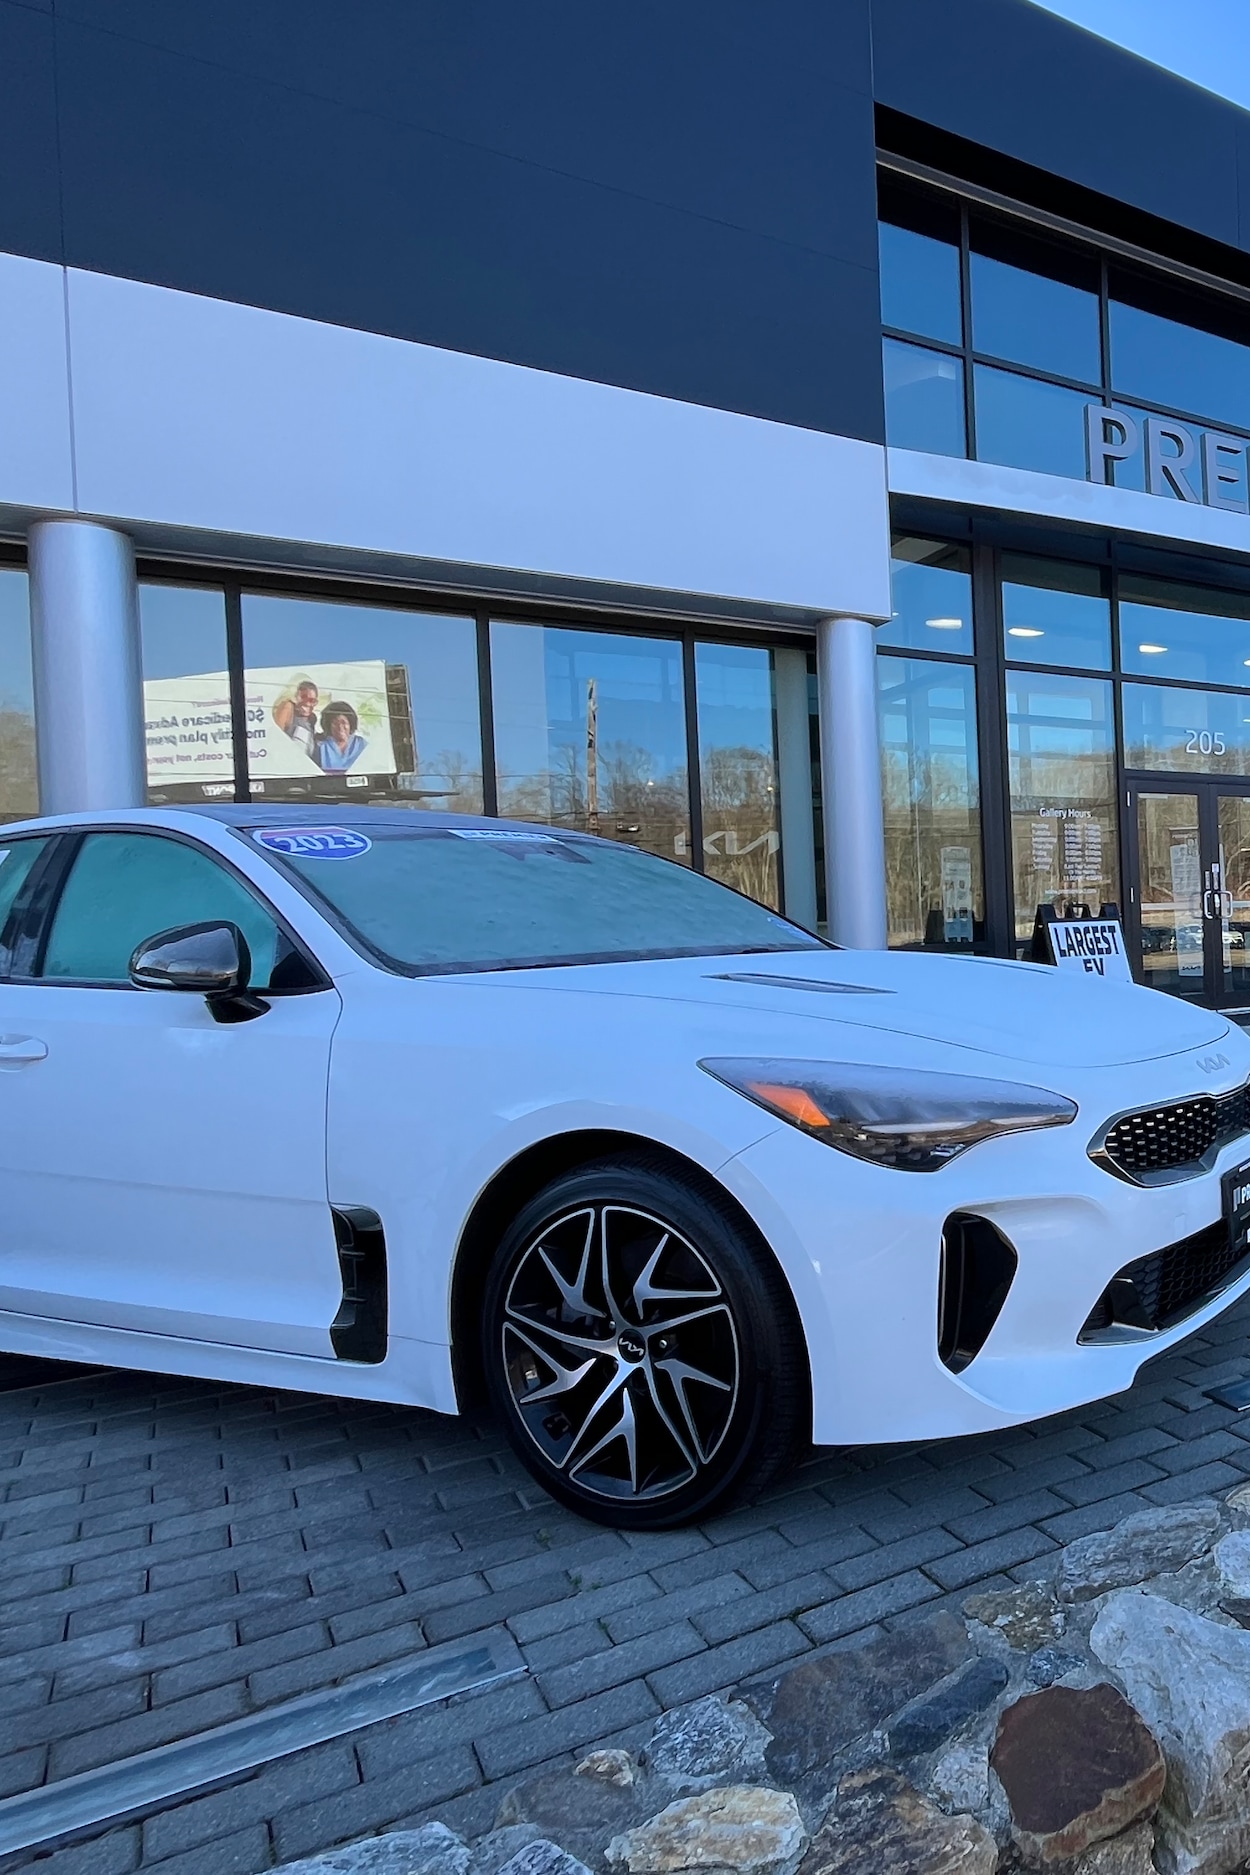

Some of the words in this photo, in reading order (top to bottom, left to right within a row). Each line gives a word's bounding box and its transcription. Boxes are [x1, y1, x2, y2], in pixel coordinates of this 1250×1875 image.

[1185, 729, 1226, 756] 205
[1039, 807, 1067, 820] Gallery
[1068, 808, 1091, 818] Hours
[274, 834, 364, 852] 2023
[1053, 925, 1119, 957] LARGEST
